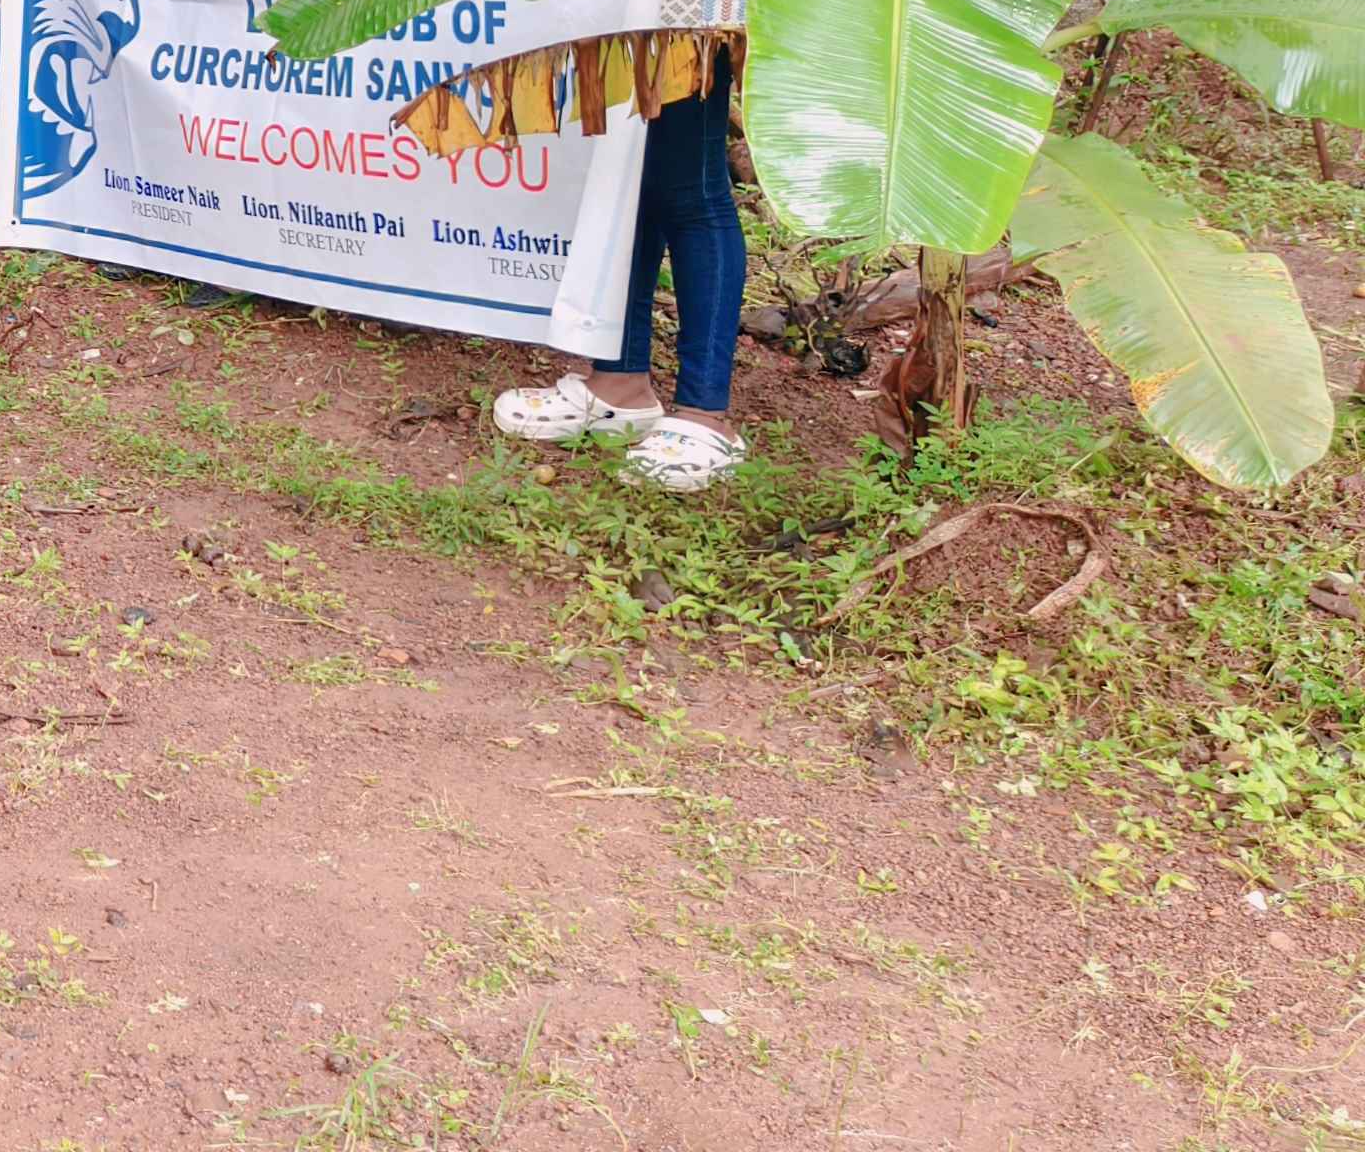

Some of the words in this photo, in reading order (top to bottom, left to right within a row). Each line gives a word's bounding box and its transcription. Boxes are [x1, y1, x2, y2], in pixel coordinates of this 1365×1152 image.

[452, 0, 507, 45] OF
[179, 114, 421, 180] WELCOMES
[442, 143, 550, 192] YOU
[104, 168, 133, 193] Lion.
[135, 175, 184, 204] Sameer
[187, 185, 221, 210] Naik
[131, 200, 194, 226] PRESIDENT
[242, 194, 284, 221] Lion.
[288, 201, 368, 233] Nilkanth
[373, 213, 405, 238] Pai
[278, 227, 366, 256] SECRETARY
[432, 219, 486, 248] Lion.
[488, 256, 566, 282] TREASU
